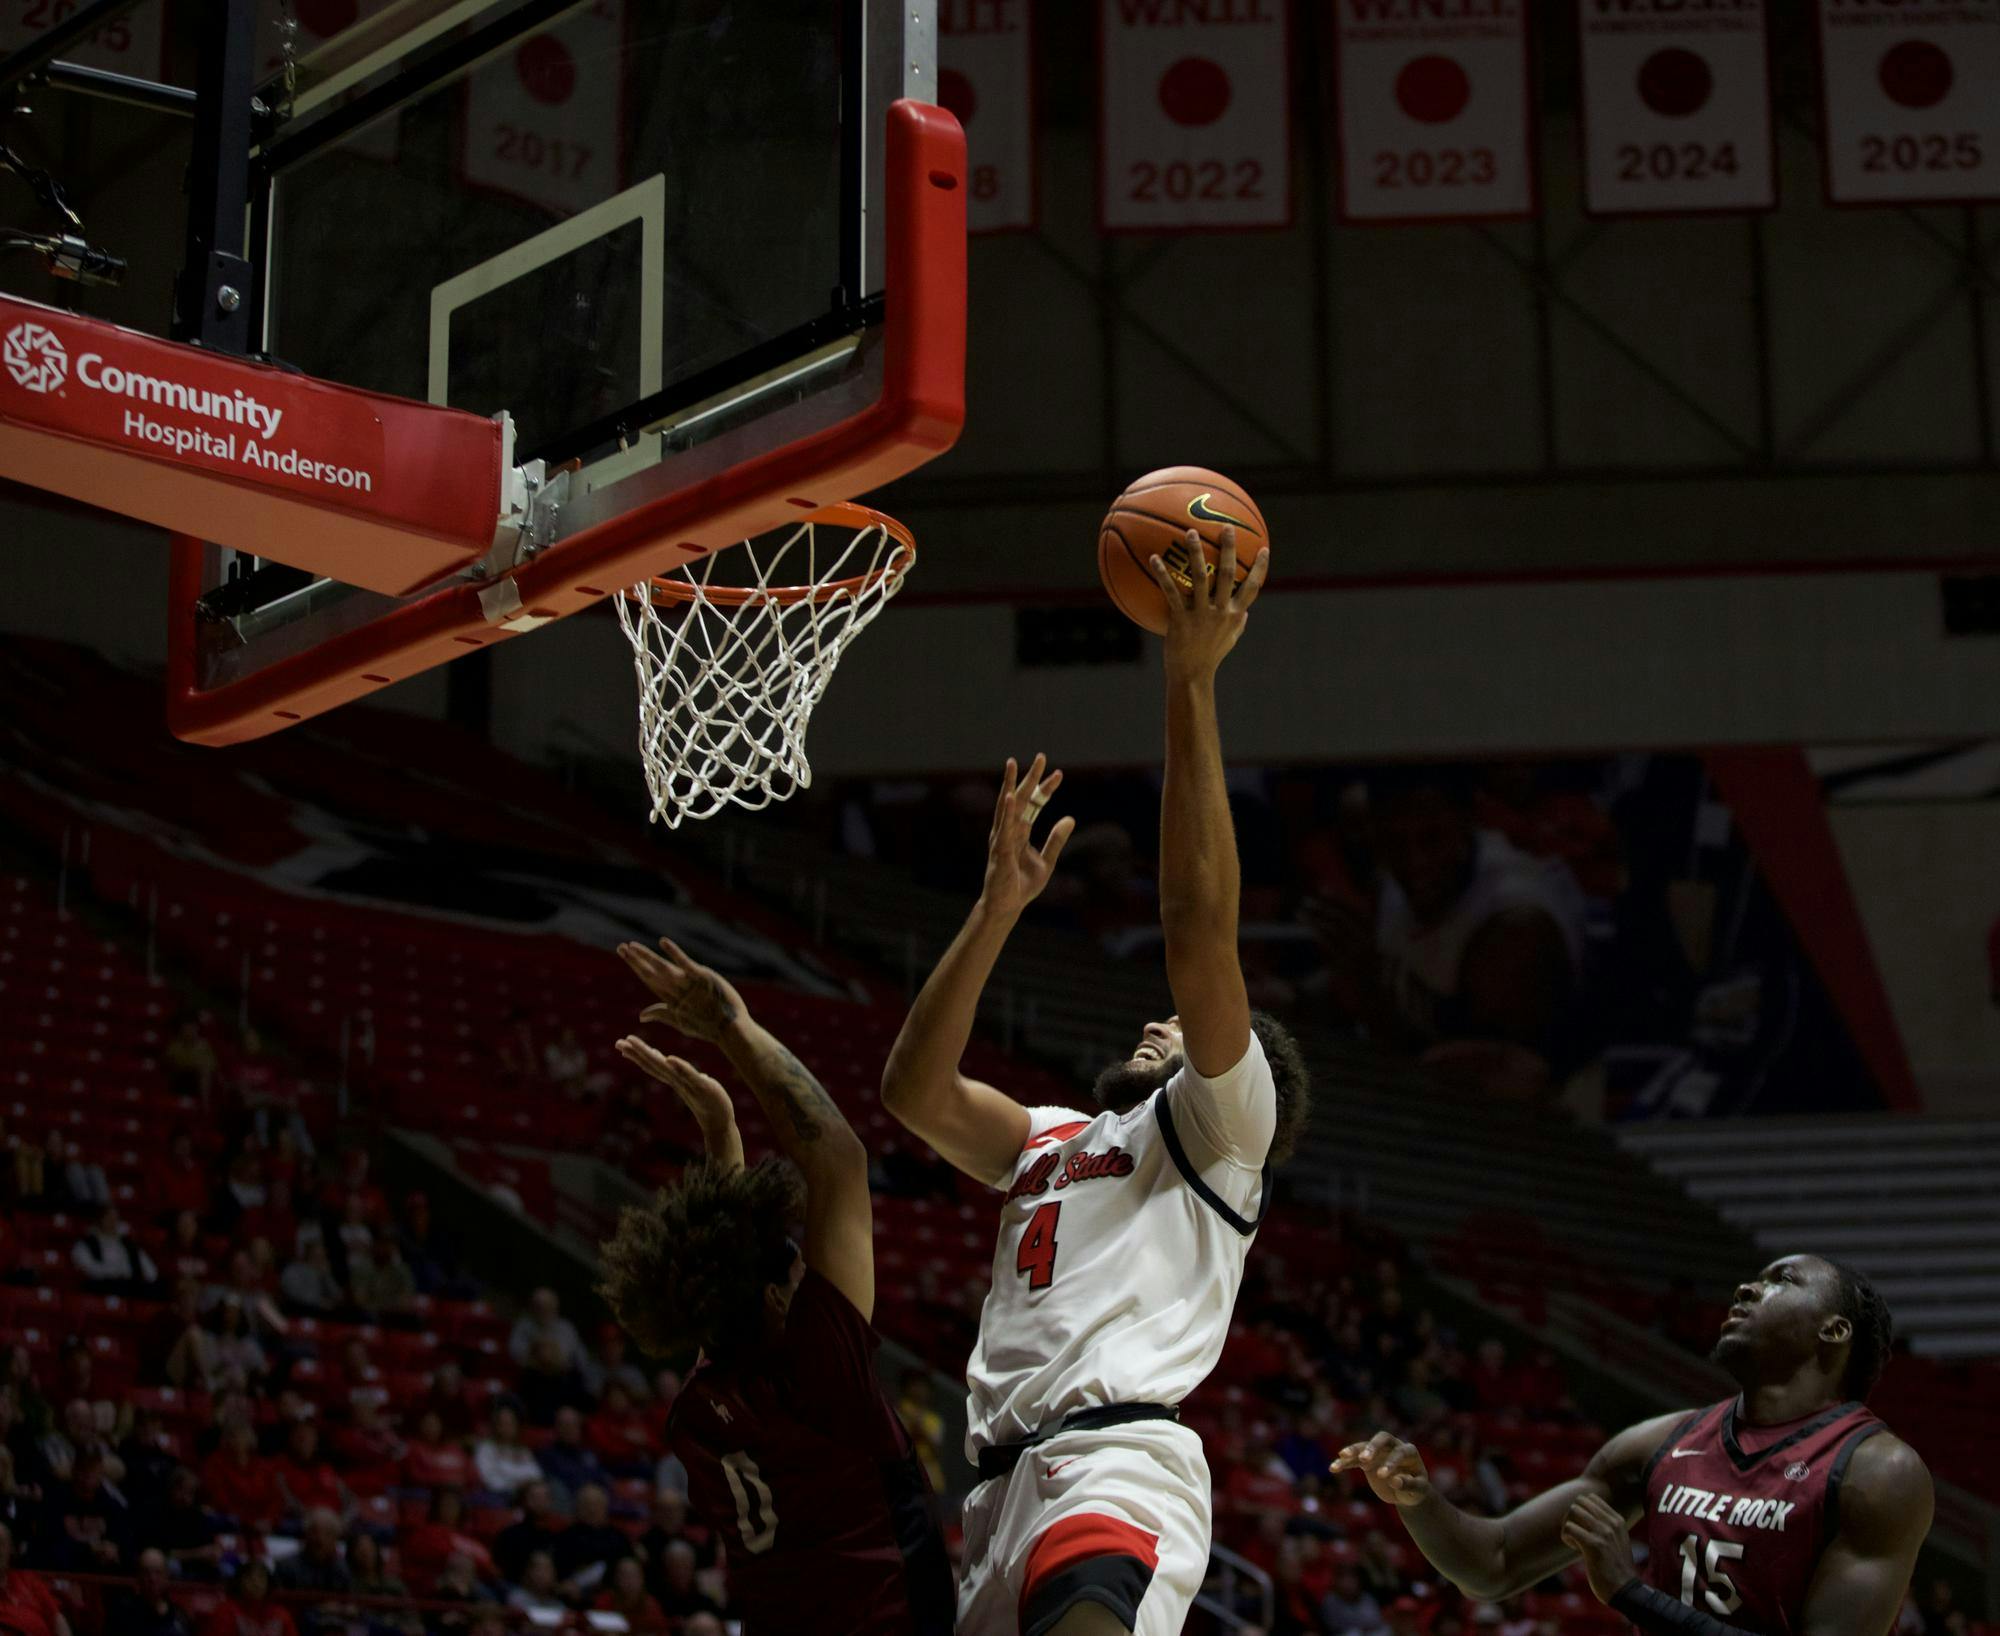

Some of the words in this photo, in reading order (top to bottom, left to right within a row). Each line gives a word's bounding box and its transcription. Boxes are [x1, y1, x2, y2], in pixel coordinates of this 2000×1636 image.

[495, 123, 592, 178] 2017
[1375, 149, 1496, 187] 2023
[1617, 144, 1738, 182] 2024
[1861, 134, 1983, 172] 2025
[1130, 160, 1263, 201] 2022
[76, 352, 282, 439] Community
[124, 409, 236, 461] Hospital
[242, 439, 372, 492] Anderson
[1054, 1146, 1135, 1190] State
[1017, 1200, 1062, 1289] 4
[721, 1449, 779, 1554] 0
[1657, 1483, 1732, 1522] LITTLE
[1727, 1498, 1795, 1533] ROCK
[1679, 1534, 1744, 1616] 15
